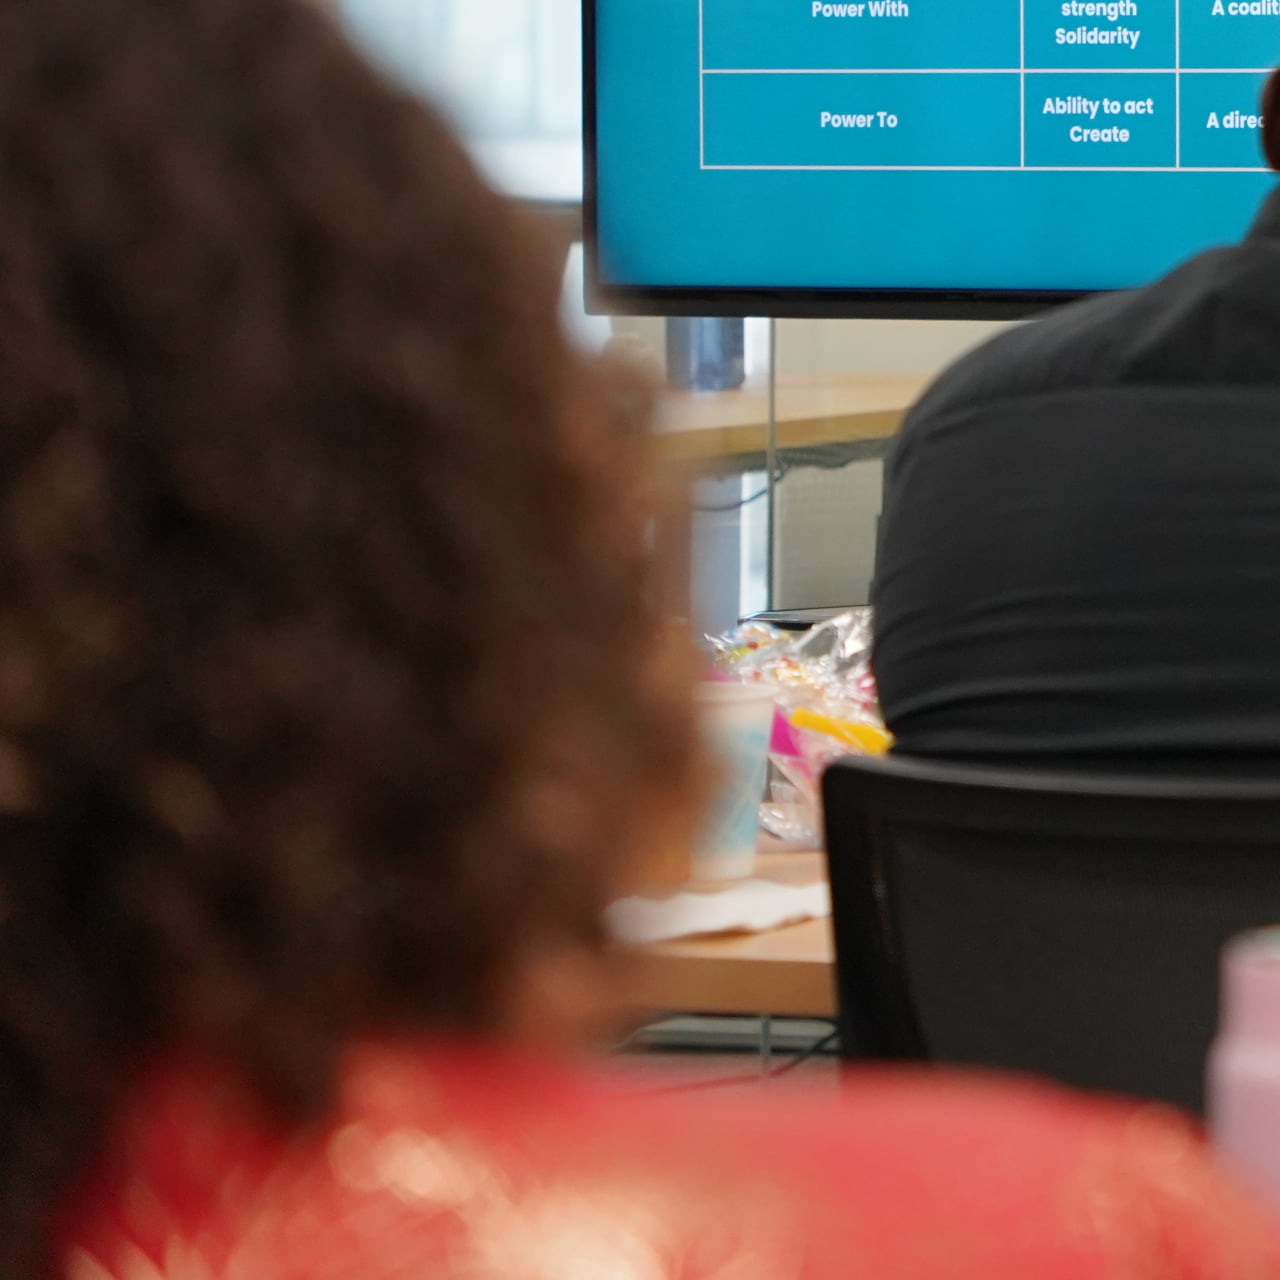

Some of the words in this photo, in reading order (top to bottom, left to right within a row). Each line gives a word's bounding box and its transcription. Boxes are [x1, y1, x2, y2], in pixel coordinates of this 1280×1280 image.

[811, 0, 863, 18] Power
[866, 0, 909, 18] With
[1211, 0, 1225, 16] A
[1055, 26, 1140, 49] Solidarity
[1043, 97, 1099, 119] Ability
[1102, 98, 1120, 115] to
[1123, 98, 1153, 115] act
[820, 111, 873, 129] Power
[876, 111, 898, 129] To
[1206, 111, 1220, 129] A
[1222, 110, 1264, 129] direc
[1069, 125, 1130, 143] Create
